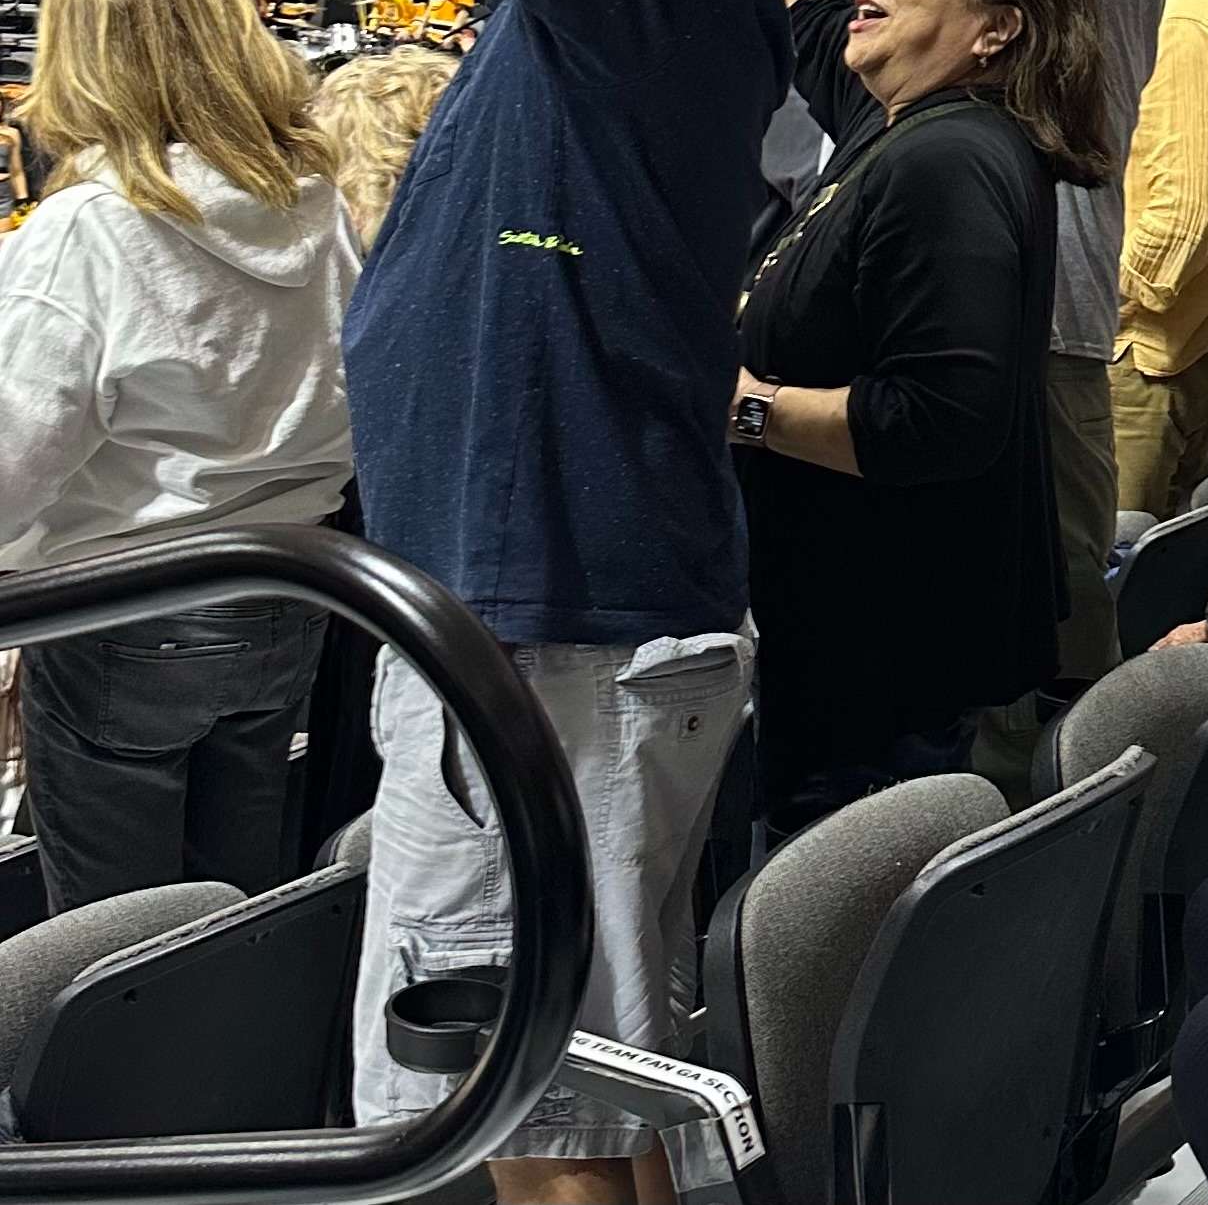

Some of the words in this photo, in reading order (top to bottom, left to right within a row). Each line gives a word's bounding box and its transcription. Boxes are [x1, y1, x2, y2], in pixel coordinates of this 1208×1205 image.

[592, 1041, 640, 1061] TEAM
[638, 1055, 678, 1072] FAN
[676, 1067, 702, 1082] GA
[702, 1076, 755, 1154] SECTION
